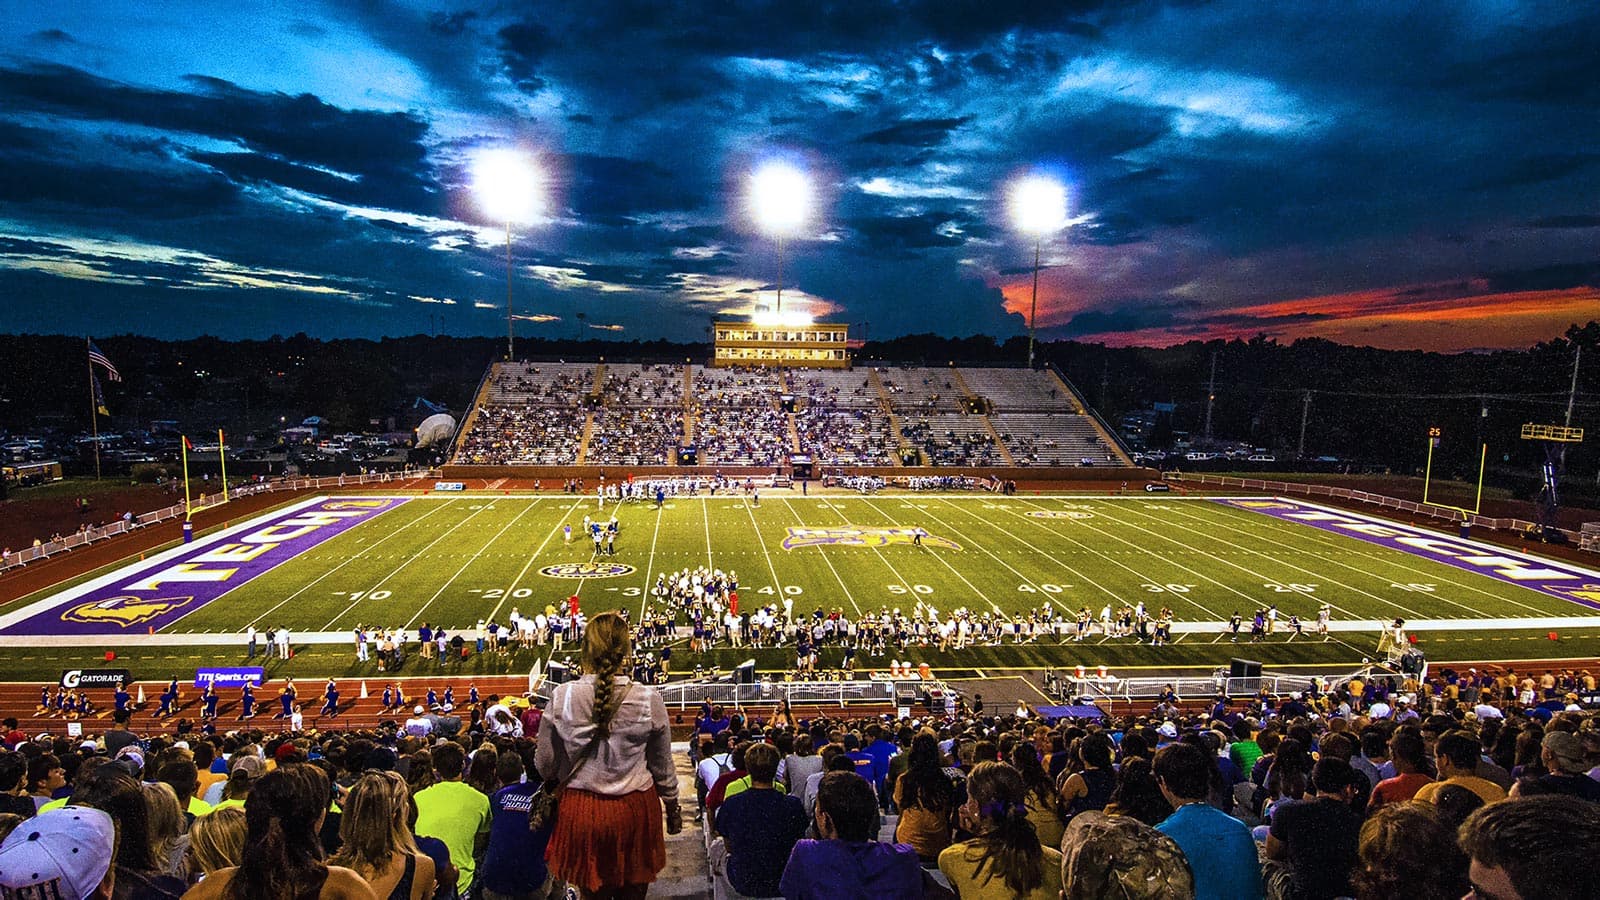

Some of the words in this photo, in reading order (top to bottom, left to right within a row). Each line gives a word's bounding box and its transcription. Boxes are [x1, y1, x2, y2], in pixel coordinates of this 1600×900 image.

[1429, 427, 1441, 436] 25
[122, 510, 370, 590] TECH
[1283, 511, 1582, 580] TECH
[756, 584, 803, 595] 40
[887, 584, 934, 594] 50
[1017, 583, 1063, 593] 40
[1141, 583, 1191, 593] 30
[1263, 583, 1316, 593] 20
[349, 590, 392, 600] 10
[481, 588, 533, 599] 20
